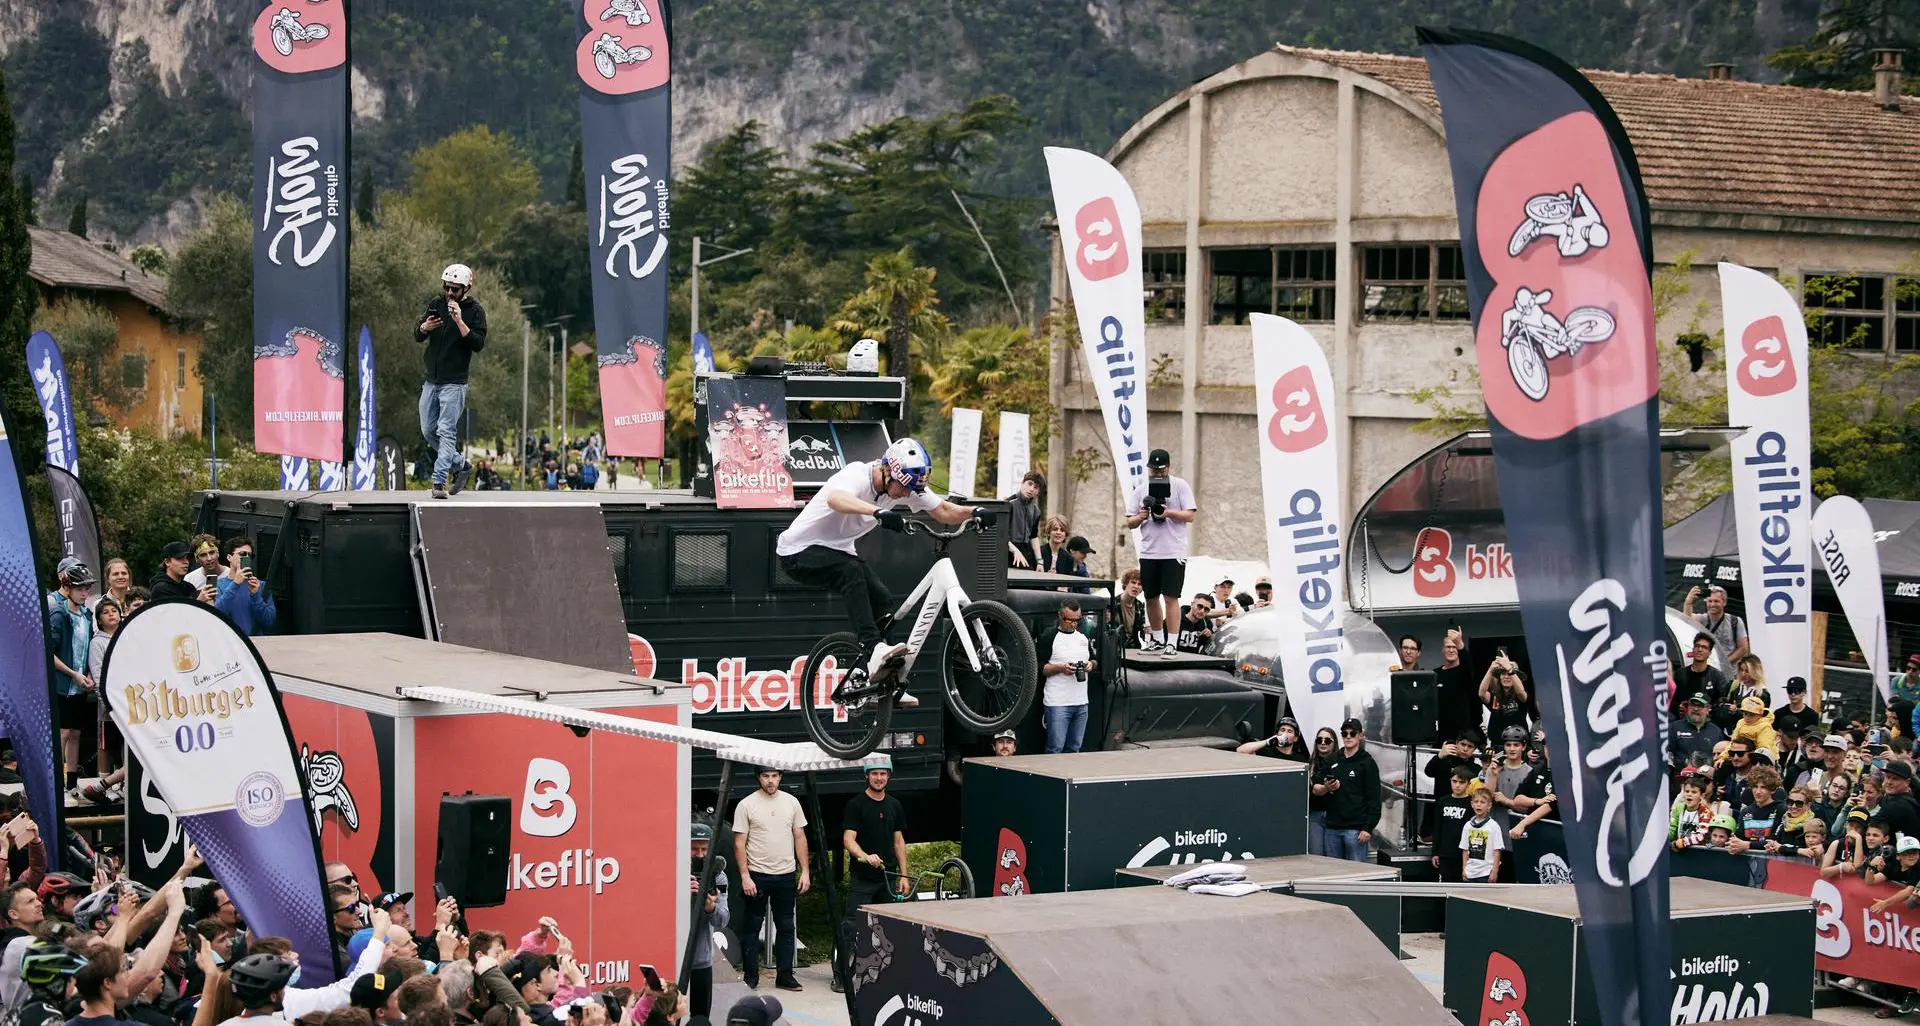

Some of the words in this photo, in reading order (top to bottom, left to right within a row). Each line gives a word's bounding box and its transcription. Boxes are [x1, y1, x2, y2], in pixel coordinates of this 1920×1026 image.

[719, 467, 789, 492] bikeflip
[1466, 543, 1514, 580] bik
[1683, 562, 1707, 578] ROSE
[1716, 565, 1741, 581] ROSE
[1895, 582, 1920, 597] ROSE
[124, 679, 255, 725] Bitburger
[175, 721, 216, 754] 0.0
[247, 786, 274, 805] ISO
[1442, 805, 1467, 820] SICK!
[1174, 828, 1229, 848] bikeflip
[505, 848, 621, 895] ikeflip
[1681, 954, 1740, 977] bikeflip
[907, 993, 944, 1021] bikeflip
